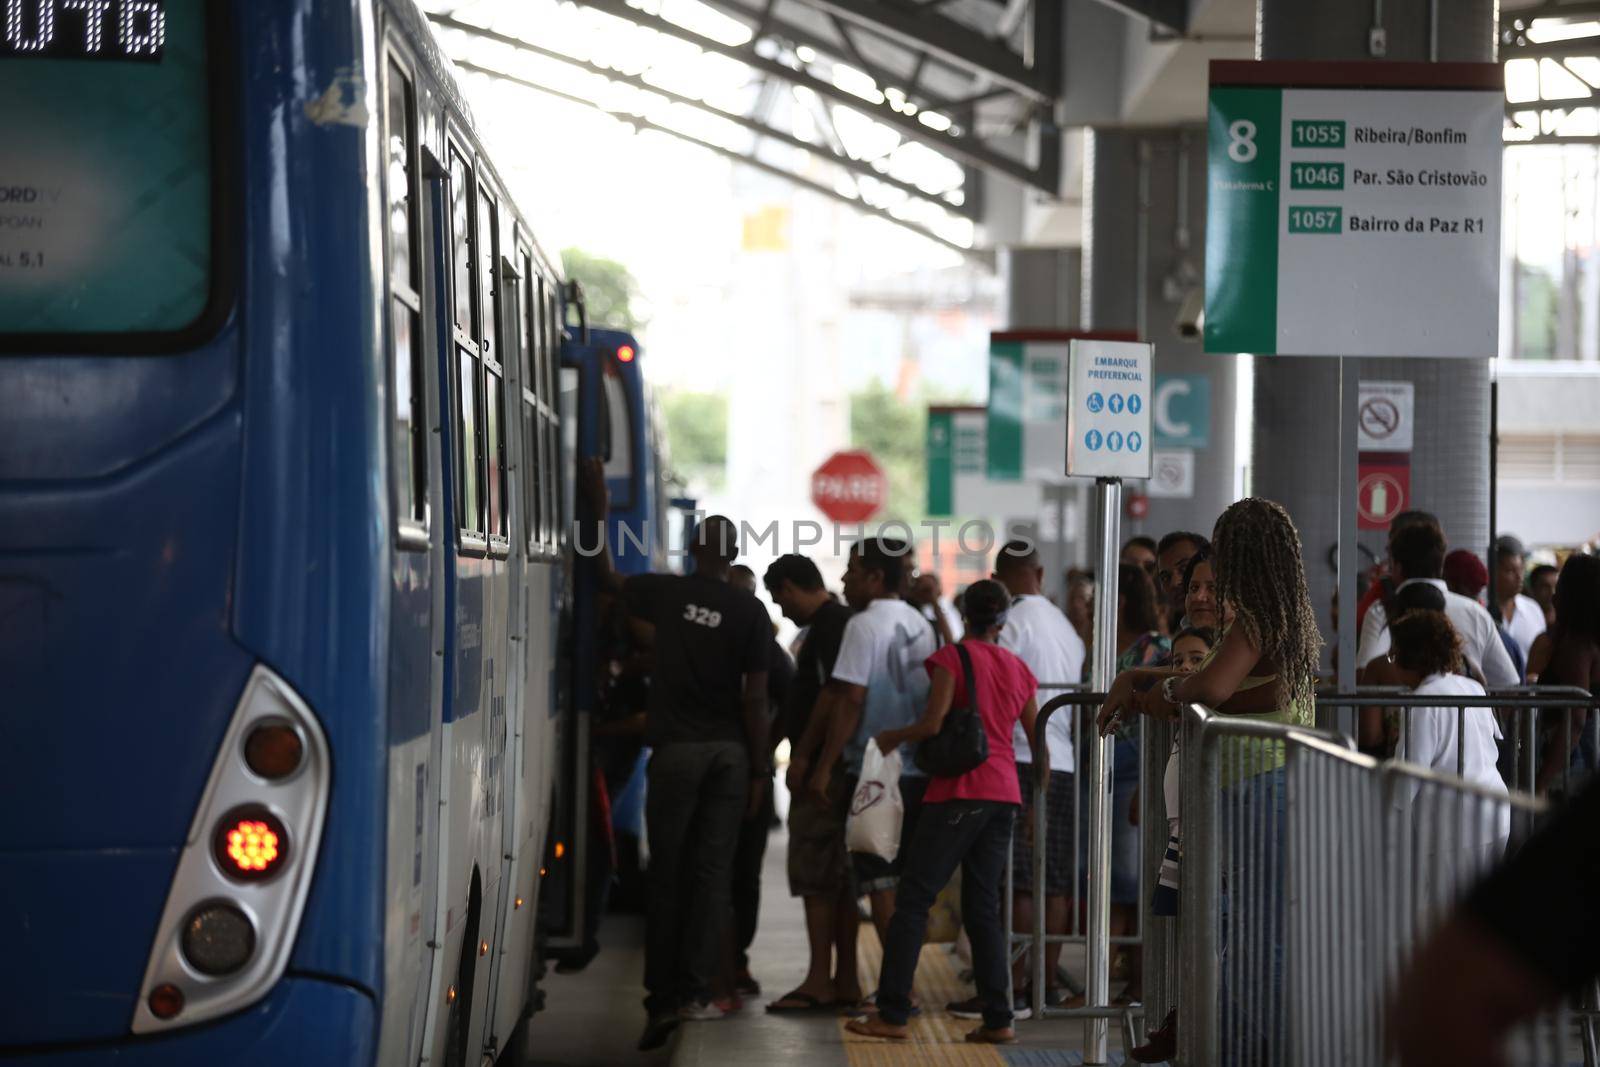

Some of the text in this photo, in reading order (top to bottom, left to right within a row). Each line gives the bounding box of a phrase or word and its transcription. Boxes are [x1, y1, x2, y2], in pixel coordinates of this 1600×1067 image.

[1228, 119, 1258, 164] 8
[1295, 126, 1467, 146] 1055 Ribeira/Bonfim
[1294, 166, 1488, 187] 1046 Par. São Cristovão
[1292, 211, 1484, 234] 1057 Bairro da Paz R1
[1094, 356, 1138, 369] EMBARQUE
[1088, 370, 1142, 382] PREFERENCIAL
[1156, 378, 1191, 437] C
[814, 474, 881, 500] PARE
[683, 603, 722, 628] 329
